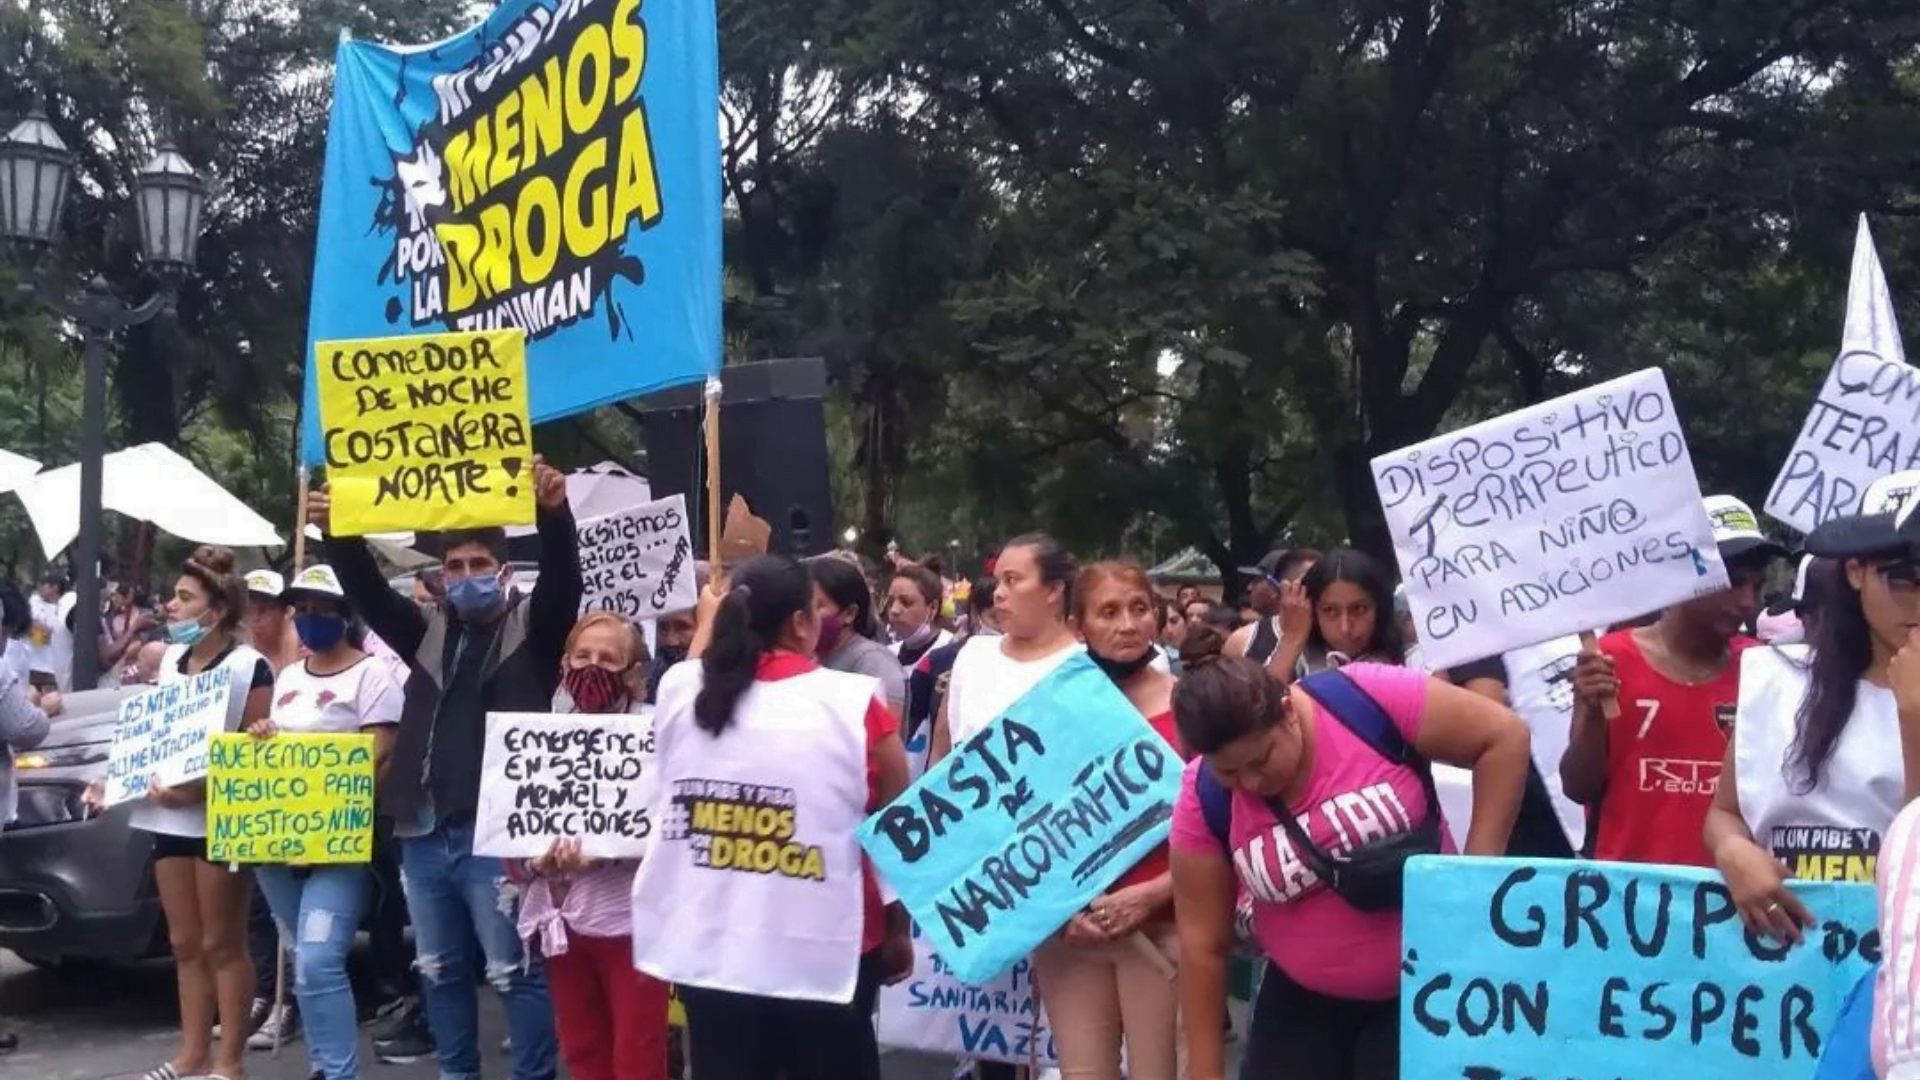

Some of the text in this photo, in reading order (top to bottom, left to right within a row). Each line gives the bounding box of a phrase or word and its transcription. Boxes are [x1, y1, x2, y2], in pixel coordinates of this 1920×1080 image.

[444, 0, 644, 213] MENOS
[398, 107, 660, 313] POR DROGA
[413, 277, 443, 320] LA
[355, 375, 512, 416] DE NOCHE
[1771, 450, 1857, 528] PAR
[620, 561, 647, 581] EL
[1409, 541, 1516, 589] PARA
[1426, 599, 1477, 640] EN
[1636, 699, 1660, 738] 7
[119, 772, 156, 799] SAN
[504, 754, 541, 779] EN
[873, 717, 1046, 863] BASTA
[998, 776, 1034, 818] DE
[710, 835, 825, 881] DROGA
[1786, 828, 1809, 849] UN
[1811, 828, 1852, 849] PIBE
[1856, 829, 1871, 849] Y
[1796, 854, 1877, 882] MEN
[1489, 866, 1803, 962] GRUPO
[1599, 976, 1821, 1060] ESPER
